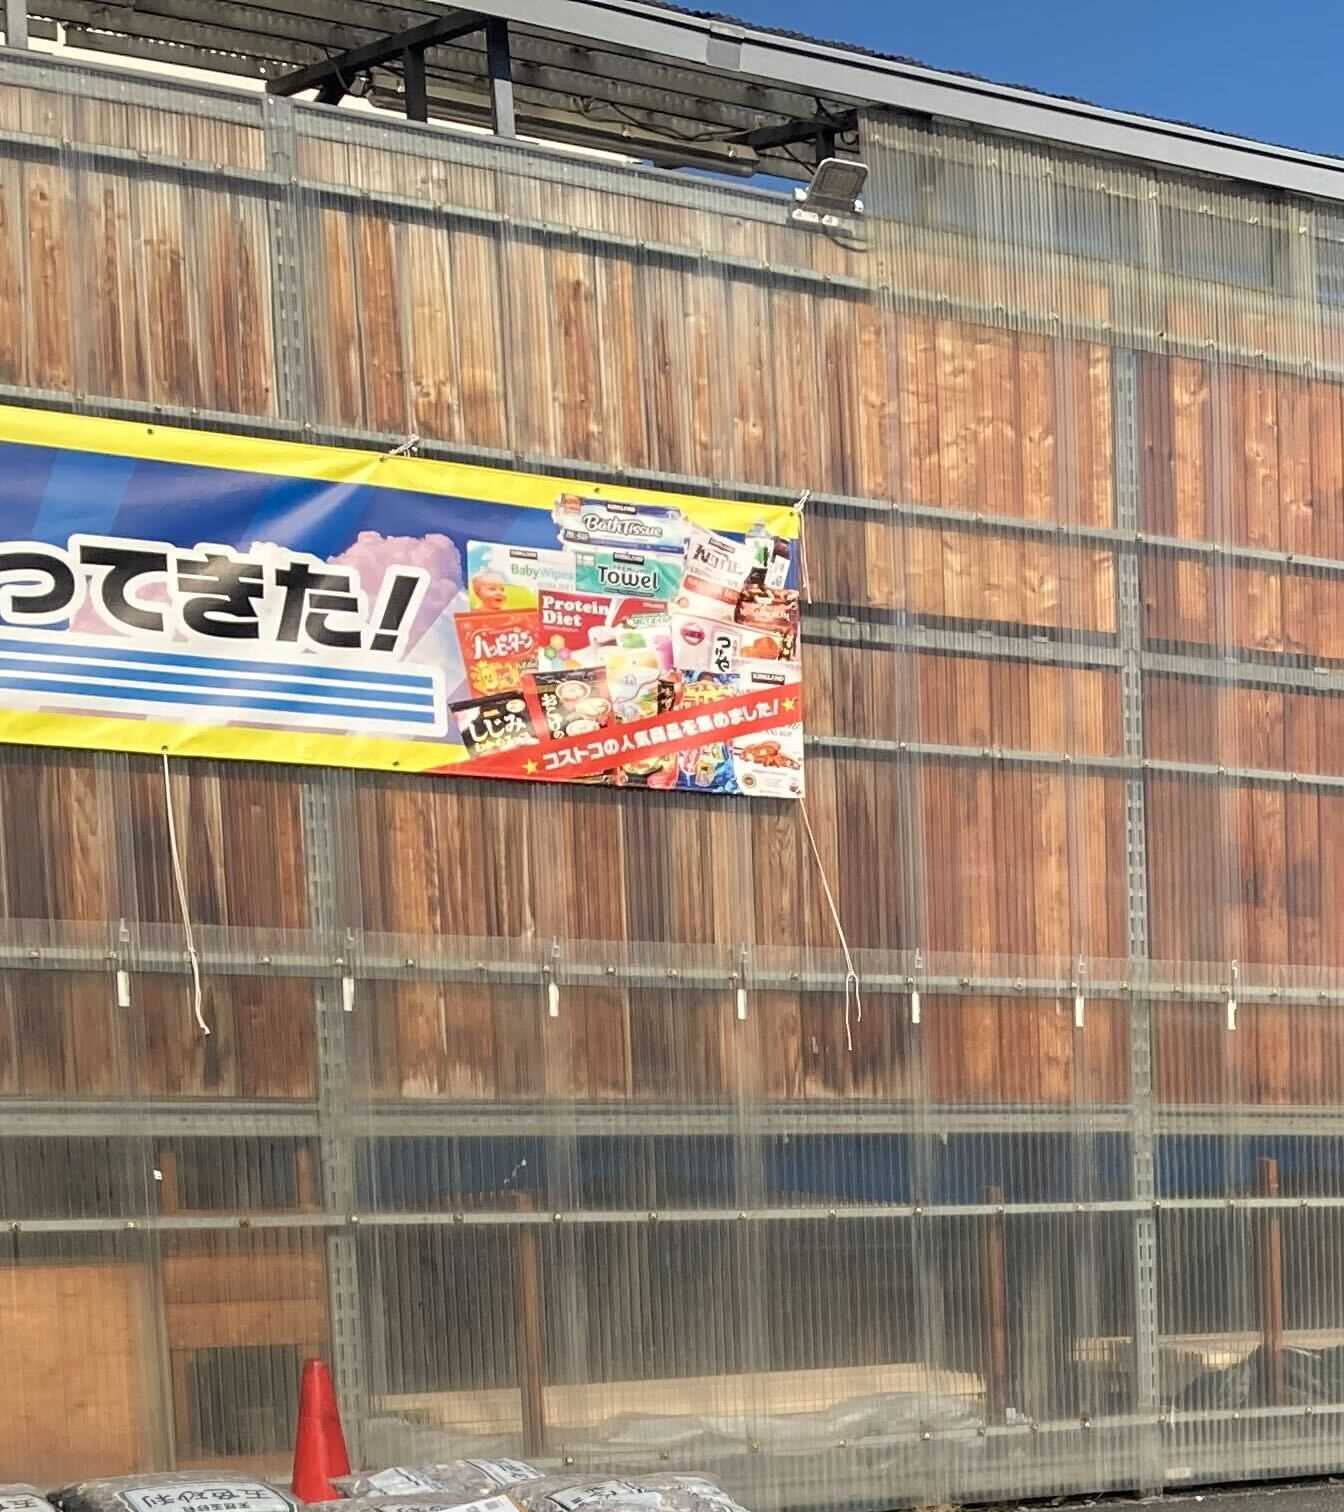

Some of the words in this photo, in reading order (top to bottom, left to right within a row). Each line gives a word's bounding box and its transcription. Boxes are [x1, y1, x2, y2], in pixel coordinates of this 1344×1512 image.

[512, 564, 538, 579] Baby
[598, 566, 659, 590] Towel
[0, 543, 421, 653] ってきた!
[542, 595, 610, 616] Protein
[542, 610, 583, 627] Diet
[139, 1488, 272, 1509] 五色砂利
